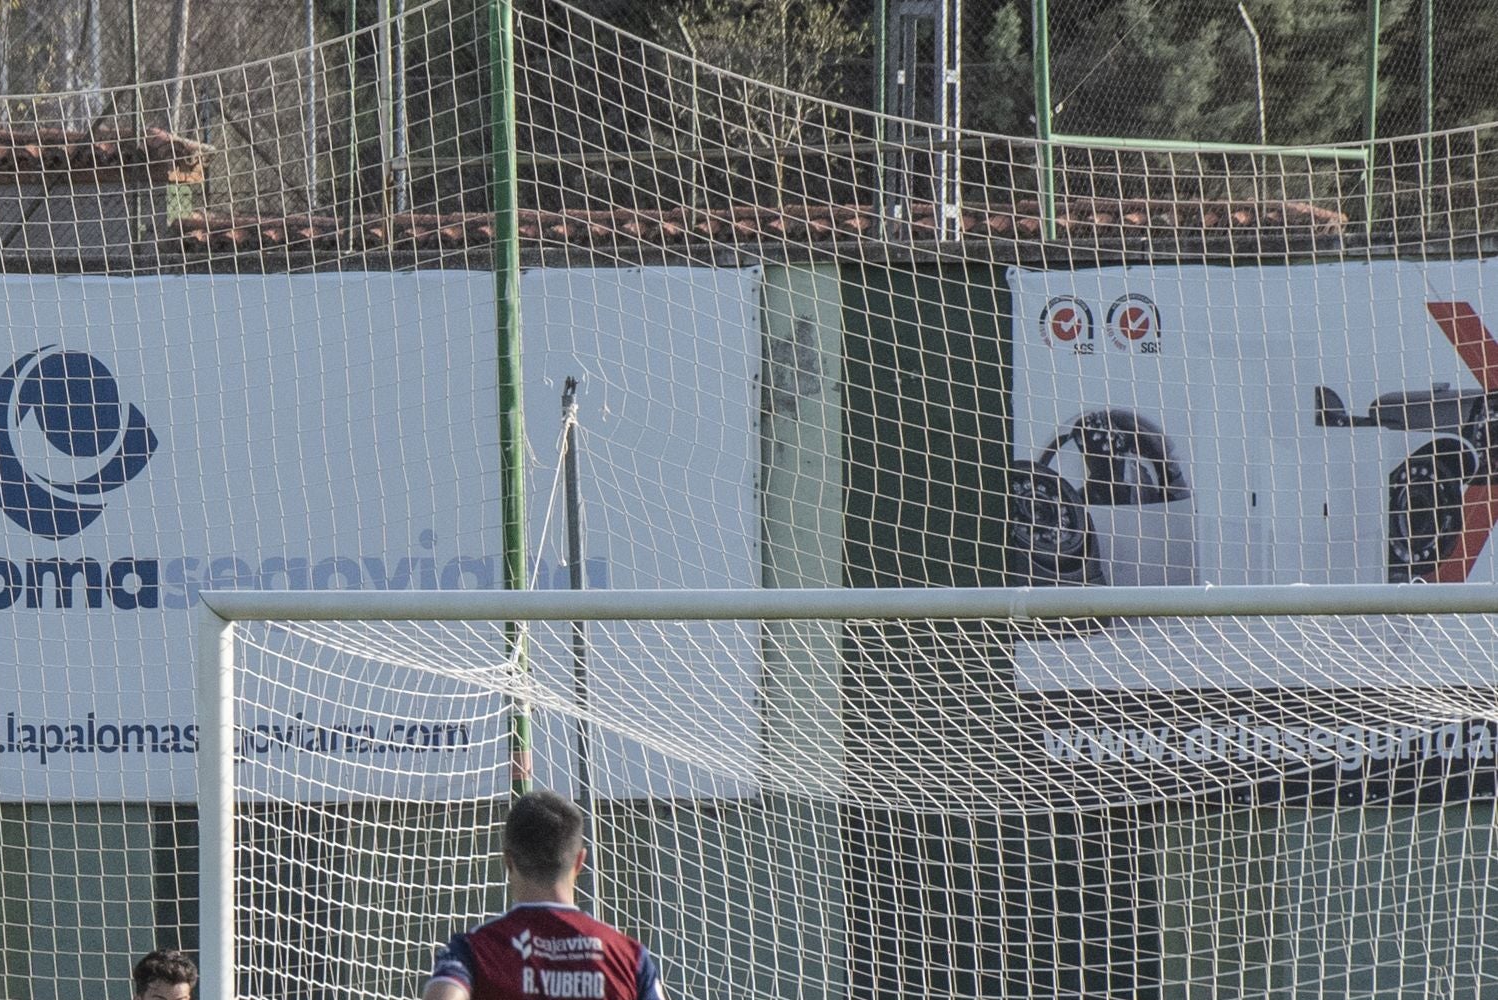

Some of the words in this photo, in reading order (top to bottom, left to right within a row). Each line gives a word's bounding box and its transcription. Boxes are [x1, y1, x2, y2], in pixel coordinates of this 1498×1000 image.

[1140, 341, 1161, 354] SGS
[523, 966, 539, 994] R.
[540, 968, 605, 999] YUBERO
